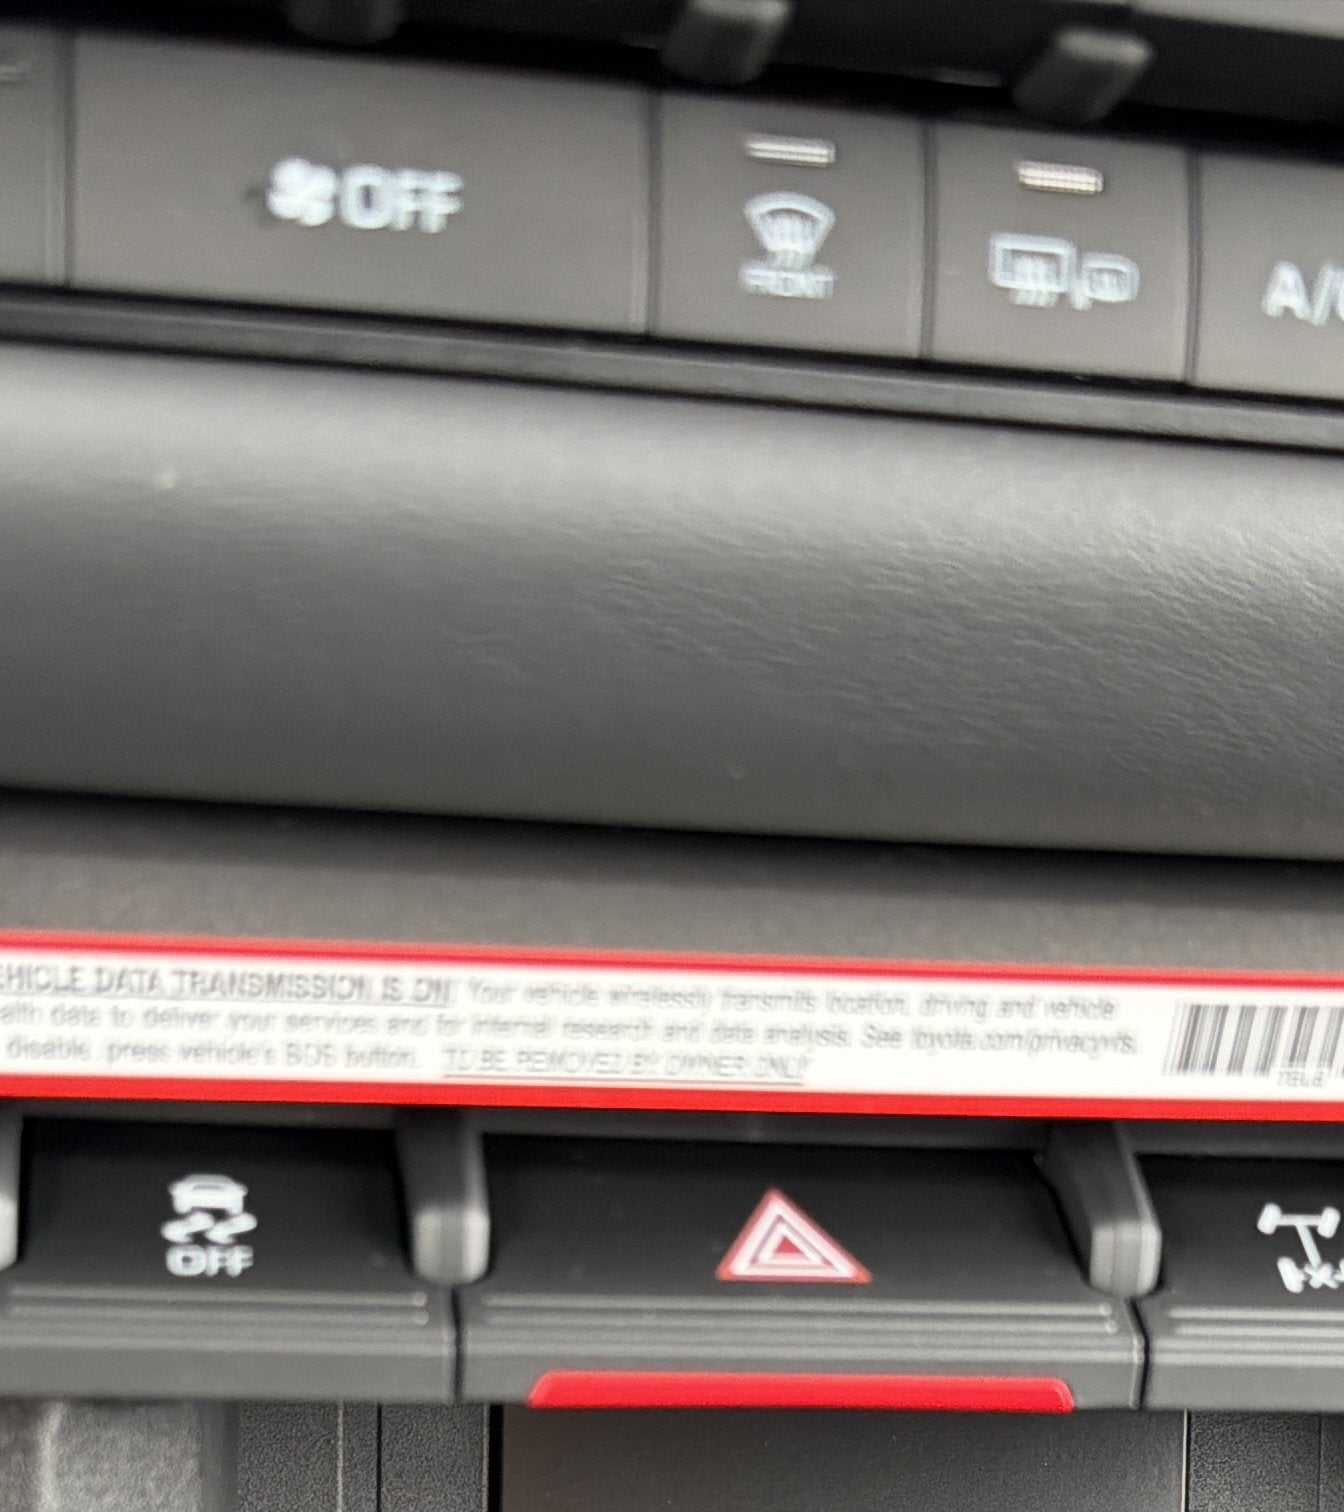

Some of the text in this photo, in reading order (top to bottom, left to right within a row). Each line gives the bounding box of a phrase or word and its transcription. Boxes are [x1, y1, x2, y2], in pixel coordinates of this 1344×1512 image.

[340, 162, 464, 233] OFF
[95, 964, 163, 994] DATA
[170, 968, 371, 1002] TRANSMISSION
[382, 975, 405, 1002] IS
[466, 978, 516, 1004] Your
[524, 980, 599, 1007] vehicle
[609, 982, 712, 1016] wirelessly
[719, 986, 818, 1014] transmits
[918, 990, 990, 1025] driving
[996, 993, 1042, 1020] and
[1045, 994, 1121, 1021] vehicle
[49, 1002, 102, 1027] data
[109, 1004, 136, 1028] to
[142, 1005, 220, 1030] deliver
[227, 1012, 276, 1039] your
[284, 1010, 380, 1035] services
[386, 1011, 429, 1036] and
[435, 1011, 465, 1037] for
[471, 1015, 552, 1041] internal
[561, 1016, 654, 1043] research
[662, 1019, 705, 1044] and
[711, 1019, 755, 1045] data
[860, 1020, 904, 1049] See
[106, 1041, 170, 1068] press
[284, 1040, 338, 1068] SOS
[478, 1047, 509, 1072] BE
[516, 1048, 624, 1075] REMOVED
[664, 1051, 746, 1077] OWNER
[166, 1245, 254, 1278] OFF
